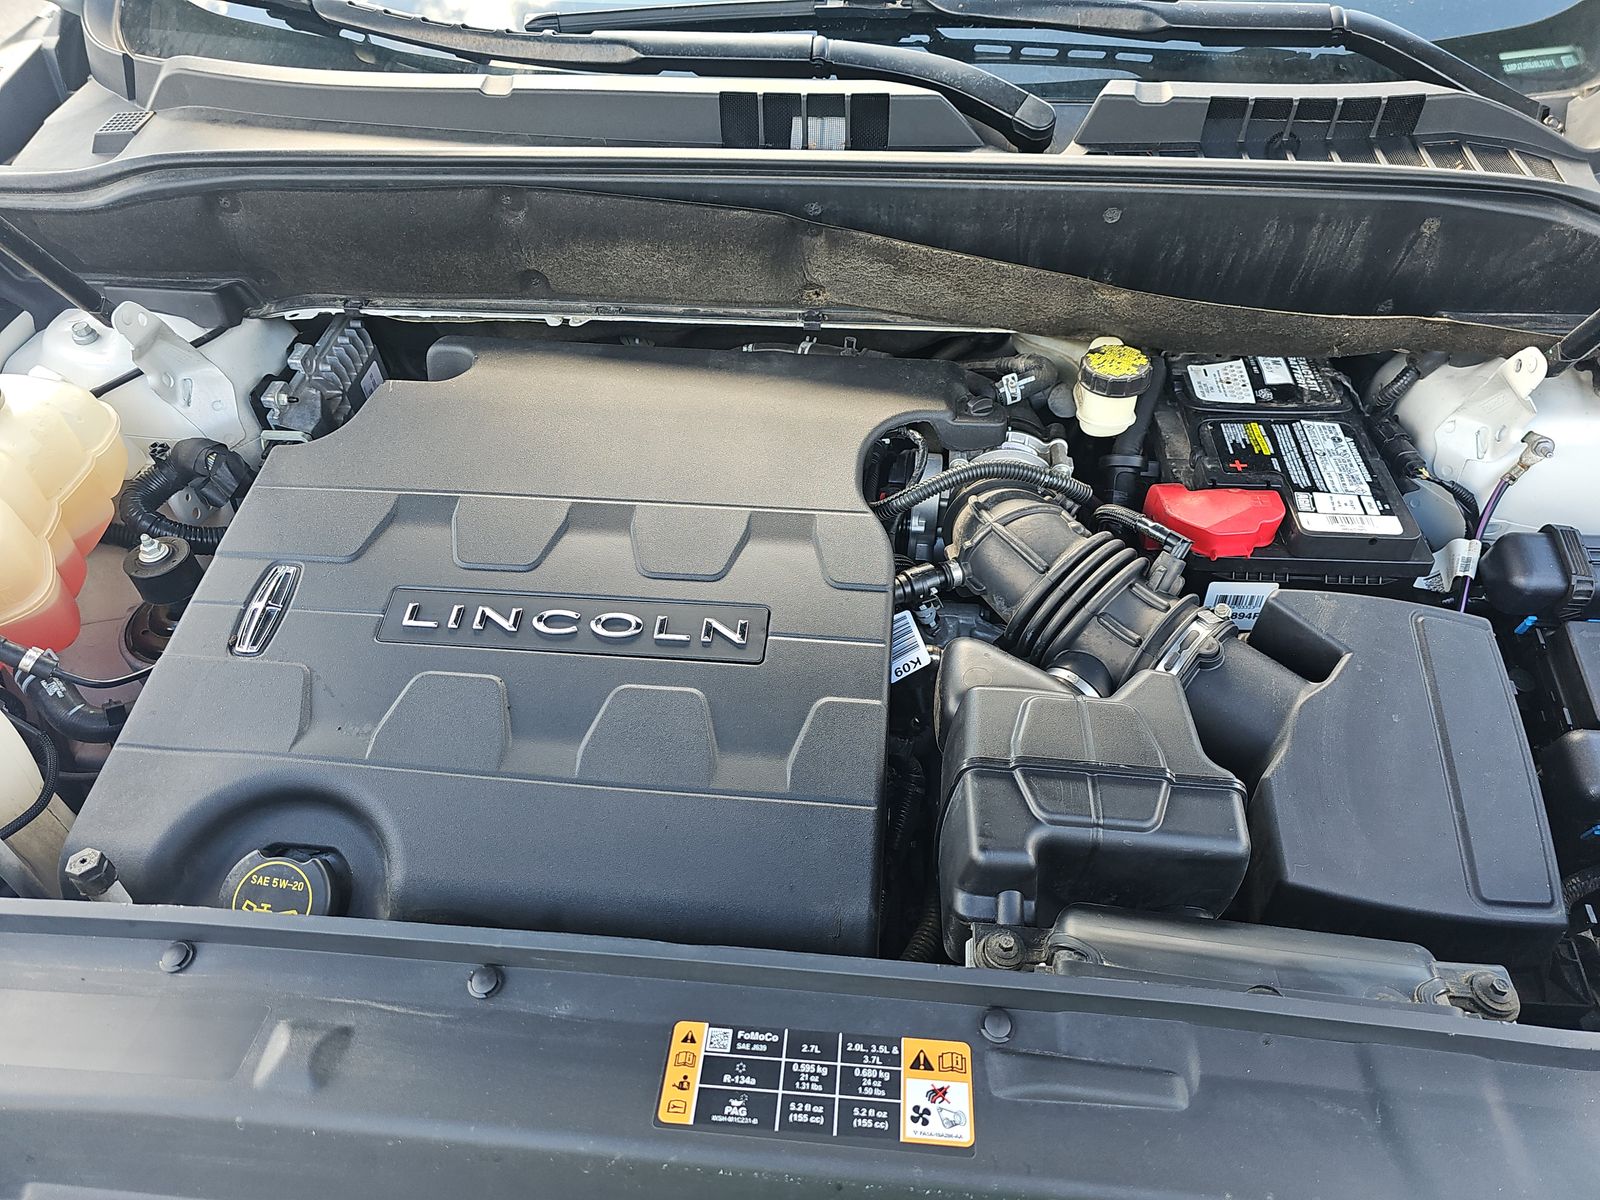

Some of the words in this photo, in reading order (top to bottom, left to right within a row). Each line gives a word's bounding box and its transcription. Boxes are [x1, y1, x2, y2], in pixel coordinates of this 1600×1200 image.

[402, 602, 750, 645] LINCOLN
[894, 656, 922, 678] K09
[250, 874, 271, 887] SAE
[271, 877, 305, 892] 5W-20
[737, 1030, 779, 1042] FoMoCo
[736, 1042, 751, 1050] SAE
[801, 1044, 821, 1054] 2.7L
[846, 1042, 869, 1053] 2.0L,
[870, 1044, 890, 1054] 3.5L
[891, 1046, 899, 1055] &
[863, 1055, 883, 1065] 3.7L
[792, 1063, 815, 1073] 0.595
[816, 1064, 828, 1076] kg
[854, 1067, 877, 1078] 0.680
[878, 1069, 890, 1081] kg
[722, 1074, 757, 1086] R-134a
[799, 1073, 808, 1081] 21
[795, 1081, 810, 1090] 1.31
[810, 1083, 823, 1091] lbs
[858, 1086, 873, 1095] 1.50
[874, 1088, 886, 1096] lbs
[724, 1106, 748, 1116] PAG
[789, 1102, 803, 1111] 5.2
[804, 1103, 811, 1112] fl
[812, 1105, 824, 1113] oz
[853, 1107, 867, 1117] 5.2
[868, 1108, 875, 1117] fl
[876, 1110, 888, 1118] oz
[788, 1113, 808, 1123] (155
[809, 1115, 825, 1125] cc)
[852, 1118, 873, 1128] (155
[874, 1120, 889, 1131] cc)
